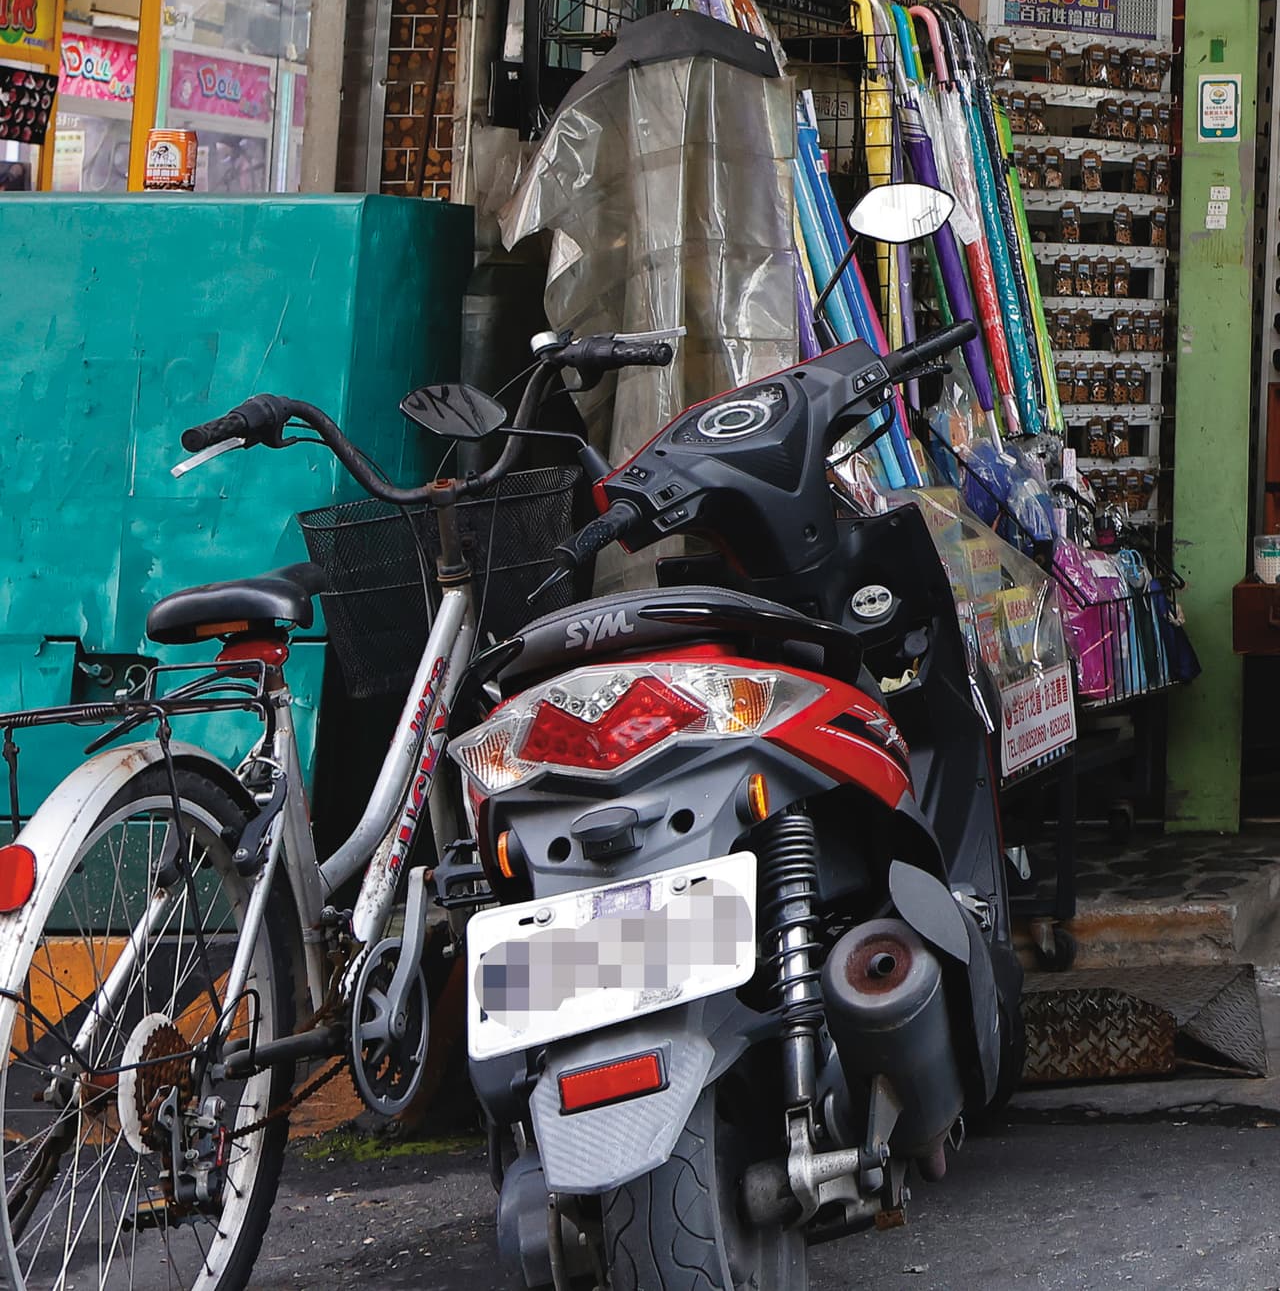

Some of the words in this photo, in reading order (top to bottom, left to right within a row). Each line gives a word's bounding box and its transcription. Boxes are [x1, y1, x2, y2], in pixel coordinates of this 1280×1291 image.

[62, 41, 111, 82] DOLL
[199, 64, 242, 101] DOLL
[565, 610, 635, 651] SYM
